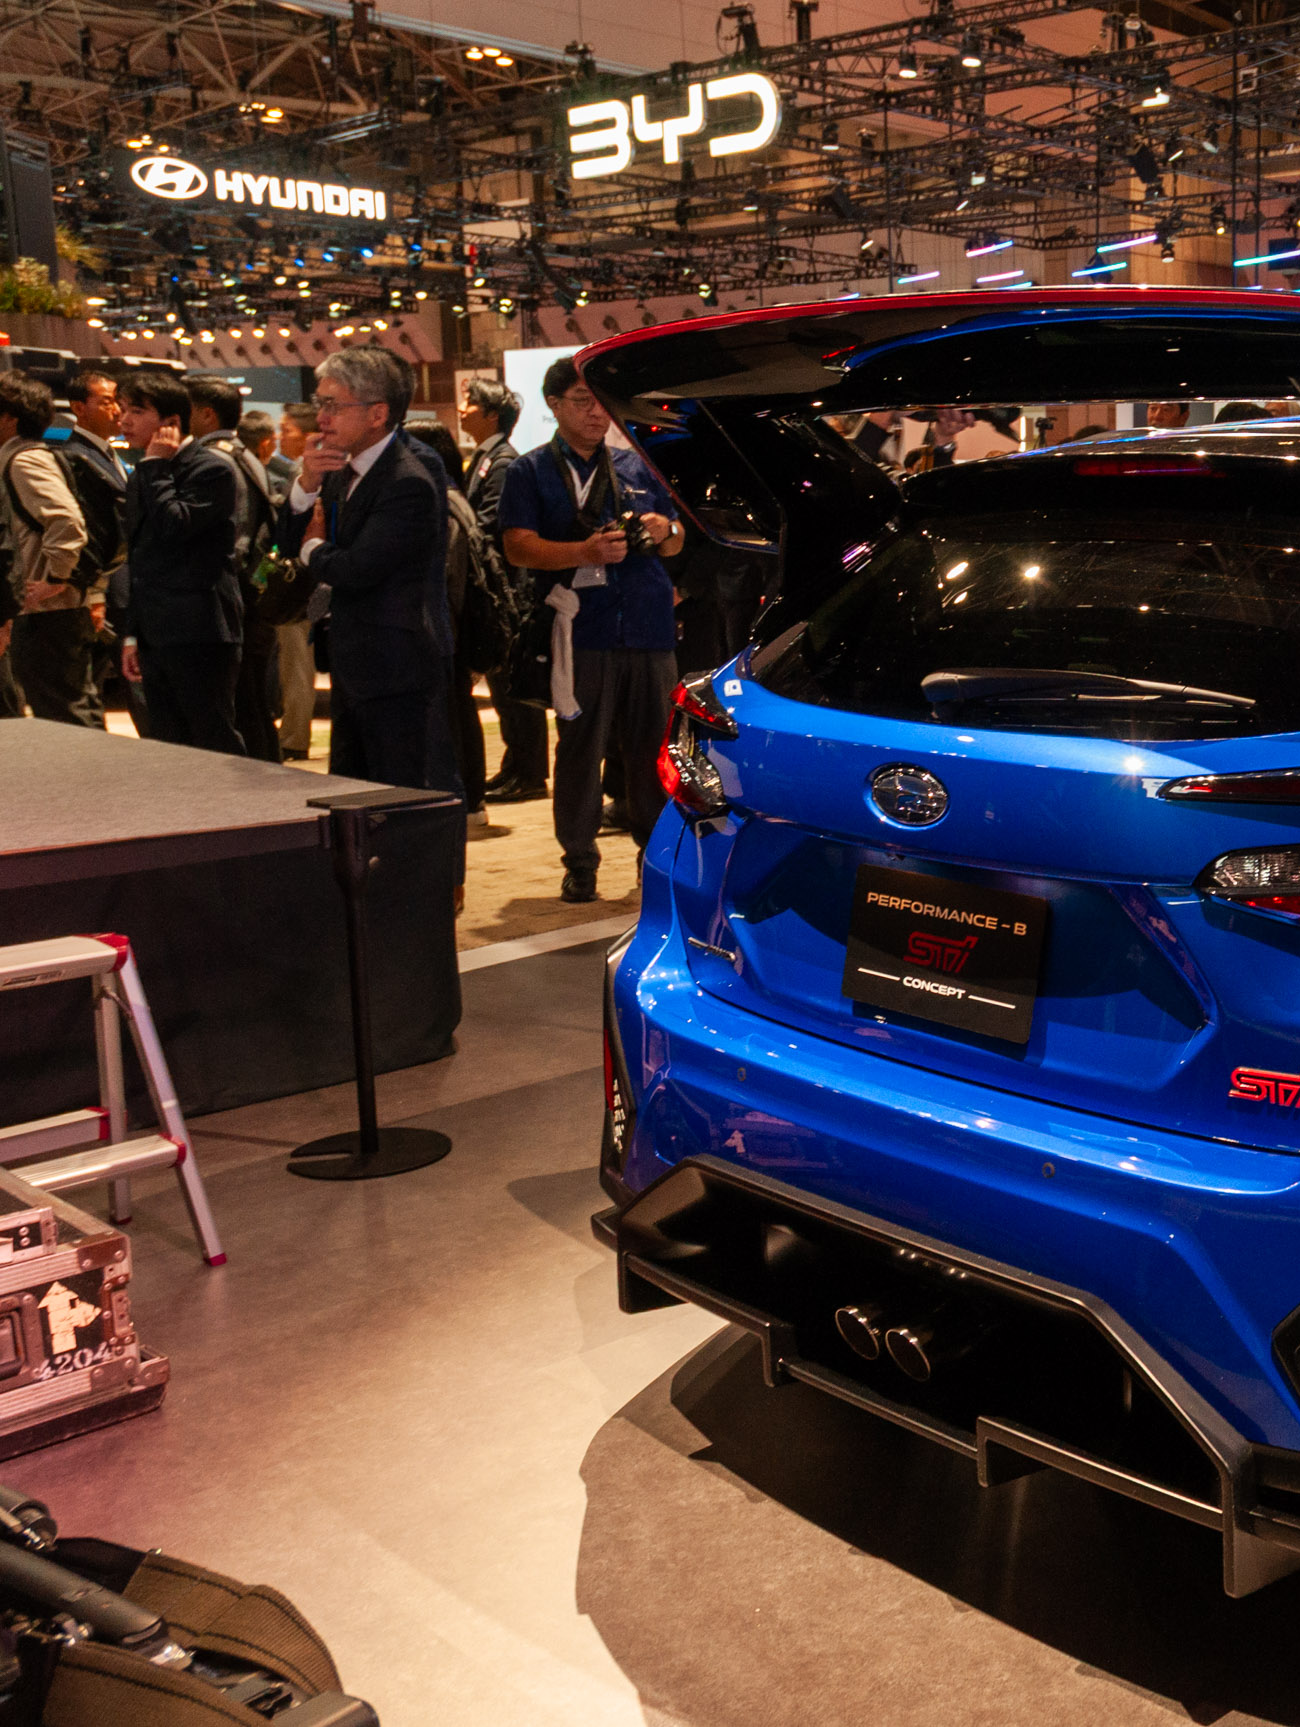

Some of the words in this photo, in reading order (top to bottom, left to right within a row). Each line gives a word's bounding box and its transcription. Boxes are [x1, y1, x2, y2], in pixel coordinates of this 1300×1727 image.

[567, 72, 782, 180] BYD
[214, 168, 387, 221] HYUNDAI
[866, 891, 999, 930] PERFORMANCE
[903, 976, 966, 999] CONCEPT
